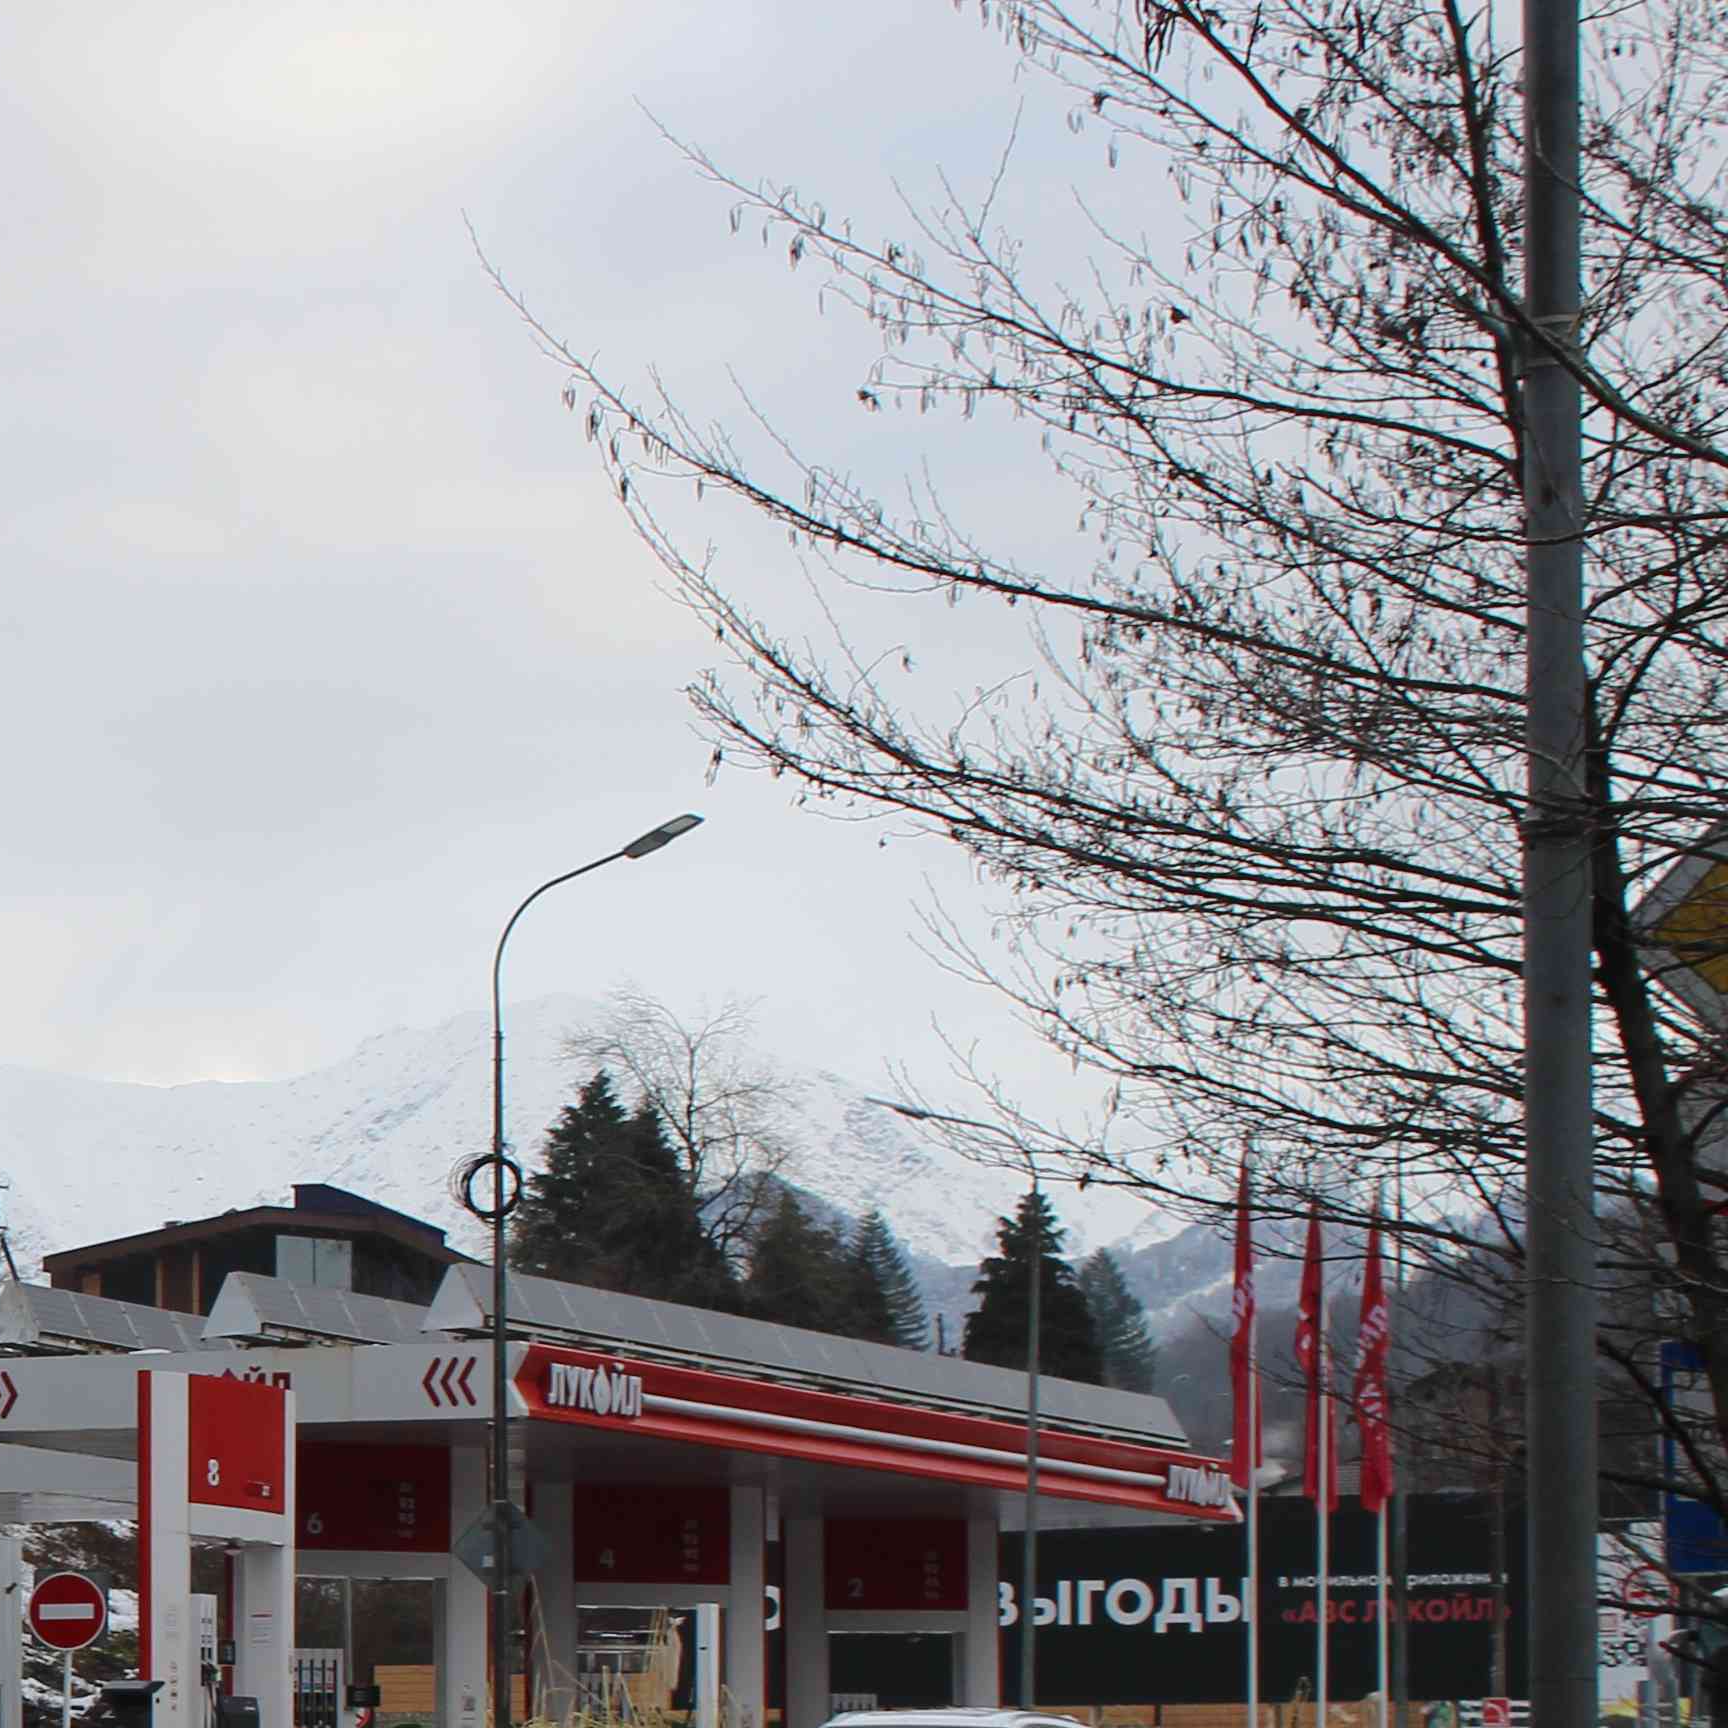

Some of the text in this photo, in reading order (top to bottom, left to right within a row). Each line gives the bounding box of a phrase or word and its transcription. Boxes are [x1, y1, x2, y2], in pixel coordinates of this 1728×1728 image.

[548, 1362, 642, 1416] ЛУКОЙЛ
[206, 1458, 221, 1487] 8
[306, 1511, 323, 1535] 6
[847, 1577, 864, 1598] 2
